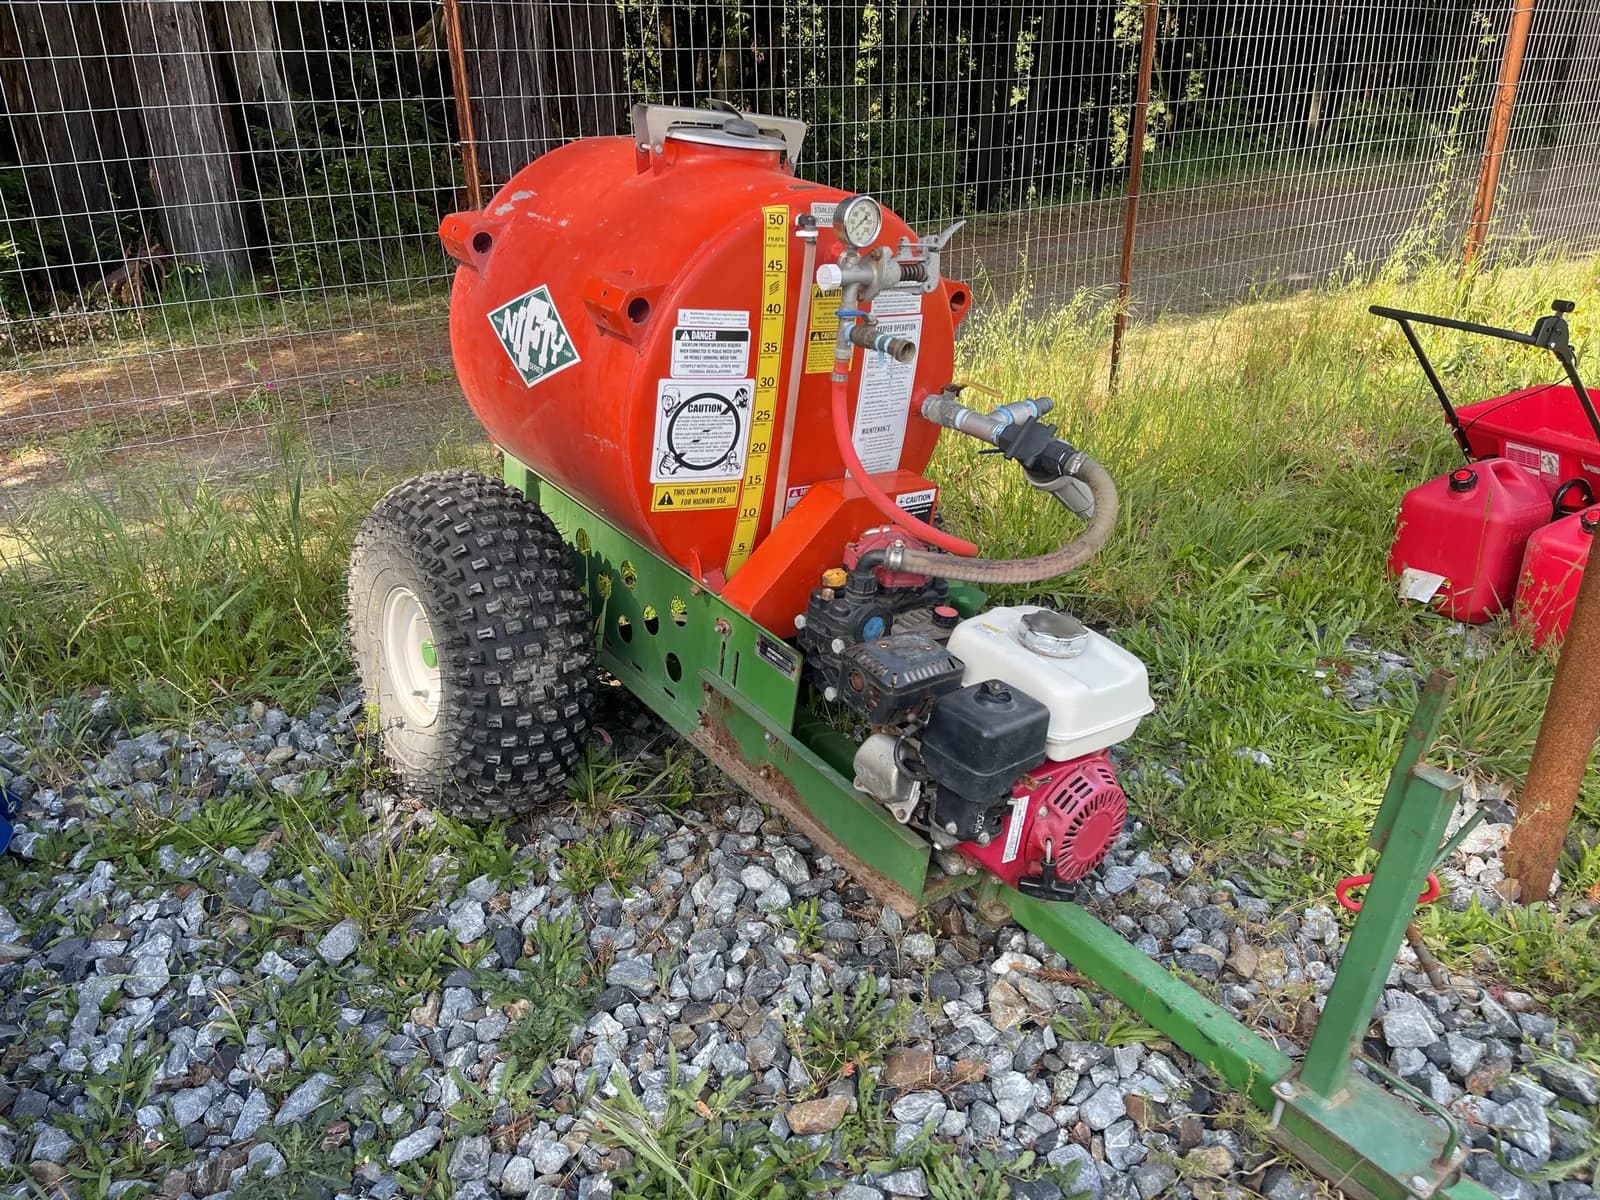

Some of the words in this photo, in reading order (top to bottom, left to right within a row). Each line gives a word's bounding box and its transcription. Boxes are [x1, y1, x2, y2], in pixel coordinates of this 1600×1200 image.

[769, 214, 784, 225] 50
[768, 260, 783, 271] 45
[766, 303, 781, 314] 40
[893, 323, 916, 332] OPERATION
[501, 296, 566, 372] NIFTY
[691, 330, 717, 340] DANGER
[763, 342, 778, 353] 35
[760, 376, 775, 387] 30
[687, 403, 722, 413] CAUTION
[756, 410, 770, 420] 25
[752, 442, 766, 453] 20
[748, 475, 762, 485] 15
[673, 488, 686, 496] THIS
[687, 488, 699, 496] UNIT
[700, 487, 710, 495] NOT
[711, 486, 736, 494] INTENDED
[681, 498, 692, 506] FOR
[692, 497, 716, 505] HIGHWAY
[717, 496, 727, 504] USE
[905, 493, 931, 504] CAUTION
[742, 508, 757, 517] 10
[738, 543, 745, 551] 5
